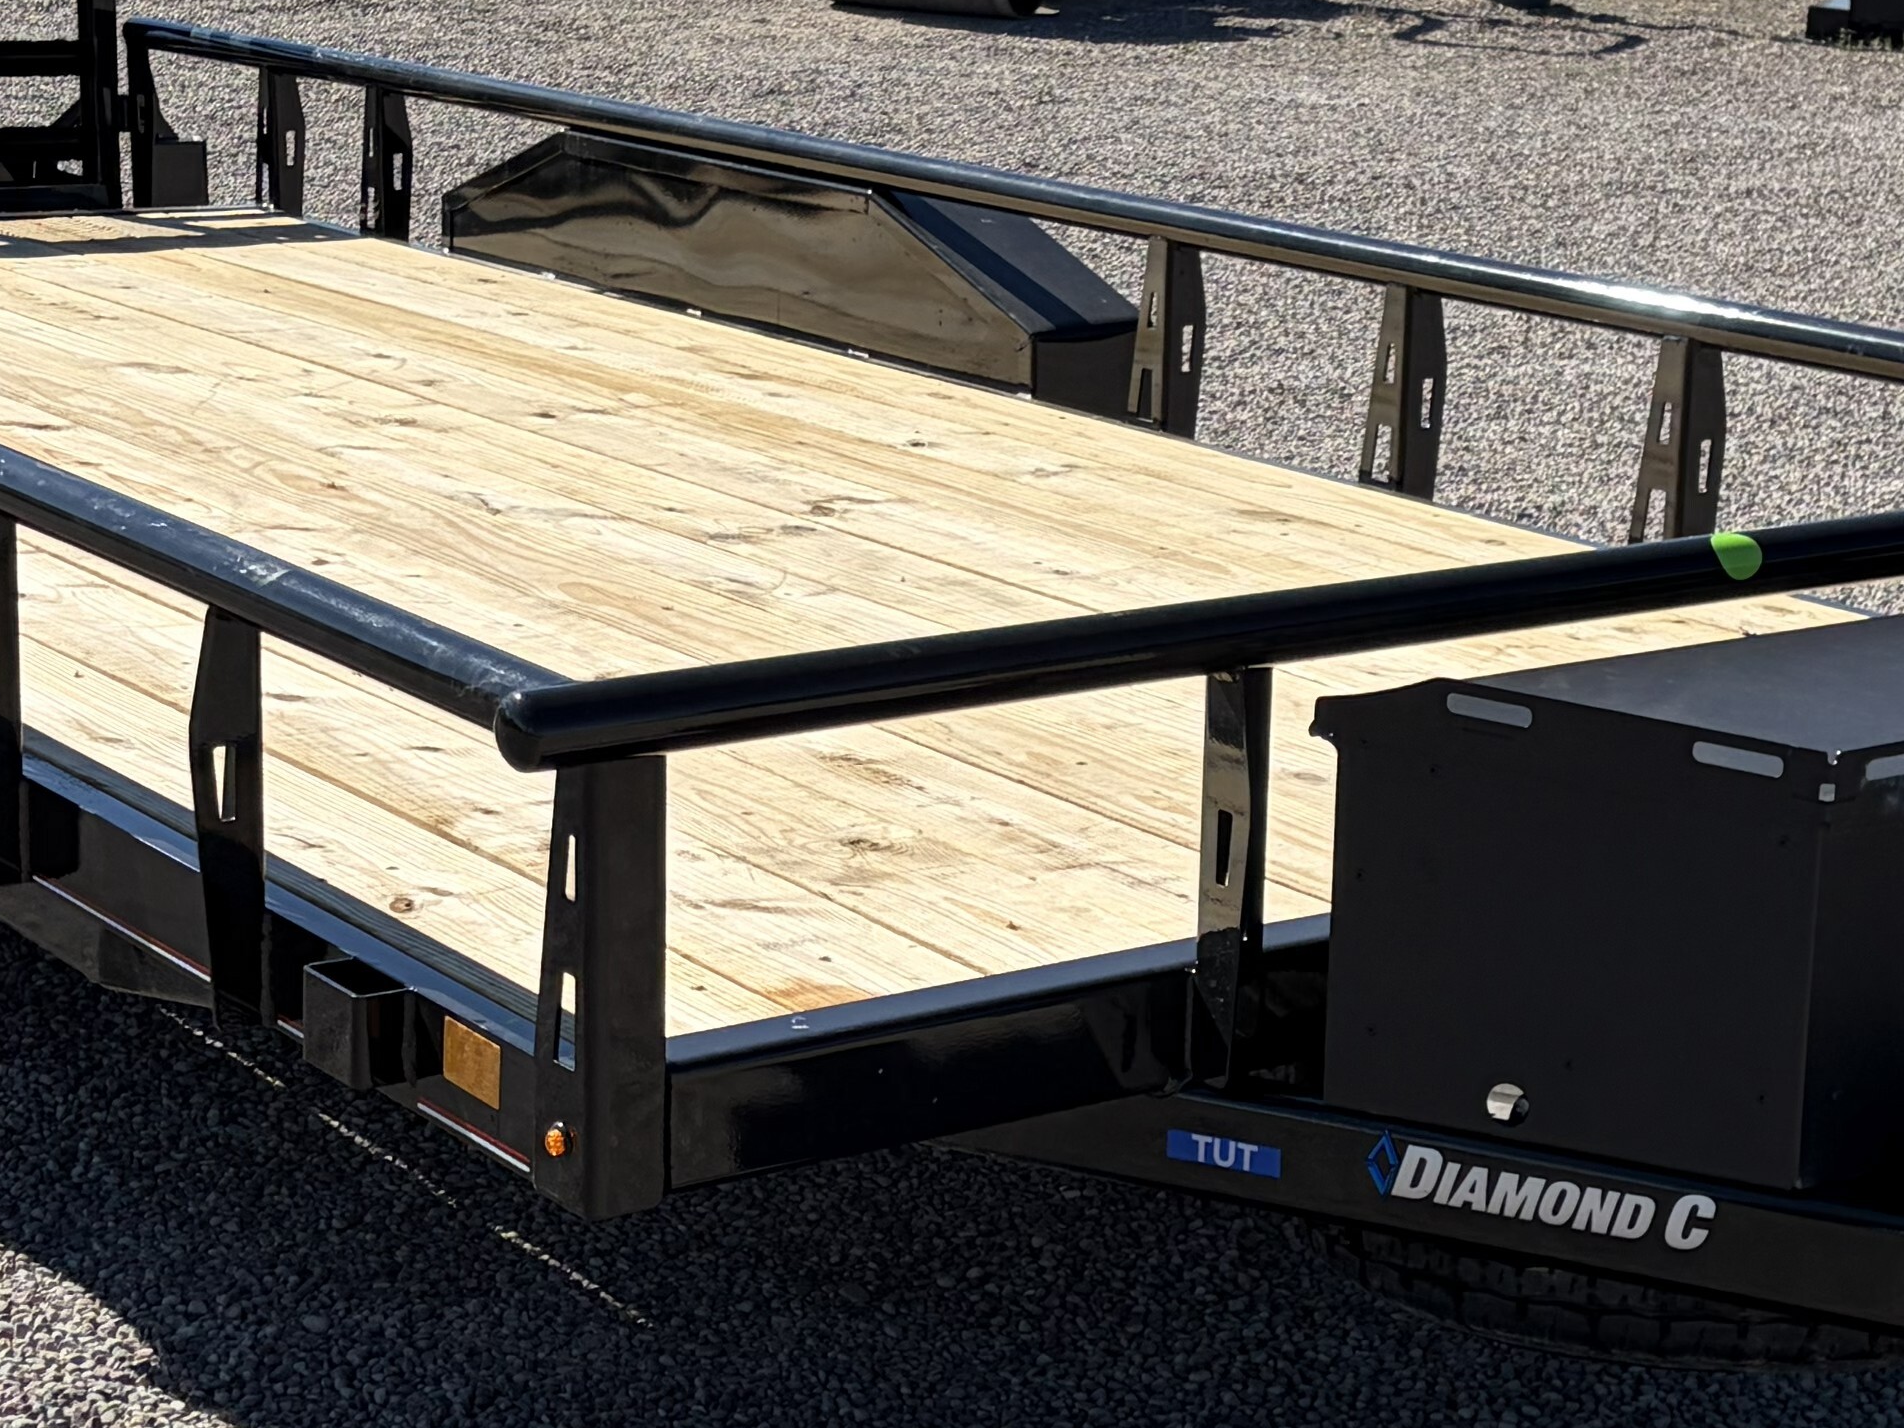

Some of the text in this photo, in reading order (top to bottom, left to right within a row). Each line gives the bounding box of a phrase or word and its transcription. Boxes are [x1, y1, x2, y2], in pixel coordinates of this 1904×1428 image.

[1191, 1133, 1260, 1173] TUT
[1391, 1143, 1718, 1251] DIAMOND C
